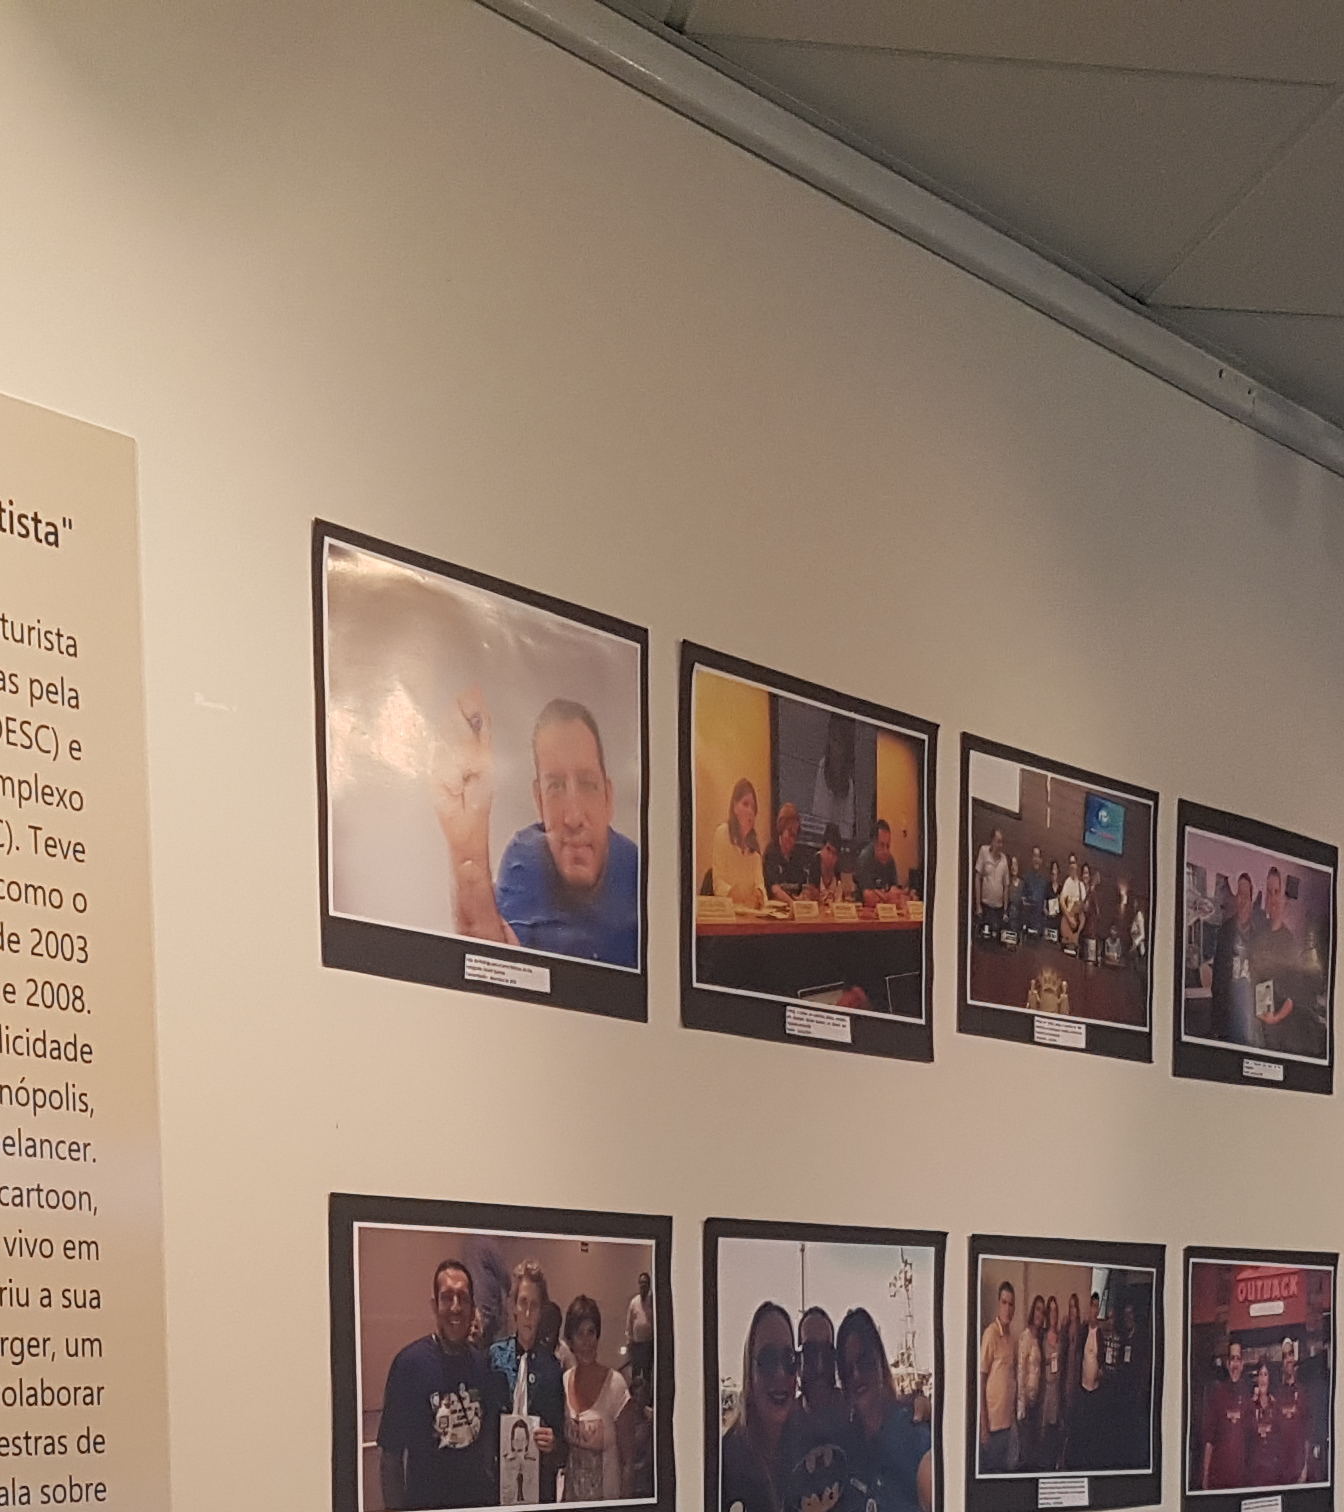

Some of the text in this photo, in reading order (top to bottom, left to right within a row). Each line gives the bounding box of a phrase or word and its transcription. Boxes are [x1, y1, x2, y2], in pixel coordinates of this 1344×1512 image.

[28, 674, 81, 711] pela
[26, 823, 86, 864] Teve
[29, 926, 90, 965] 2003
[25, 977, 92, 1015] 2008.
[1, 1227, 55, 1260] vivo
[61, 1238, 100, 1261] em
[60, 1287, 102, 1310] sua
[64, 1336, 103, 1359] um
[75, 1424, 107, 1456] de
[39, 1473, 108, 1506] sobre
